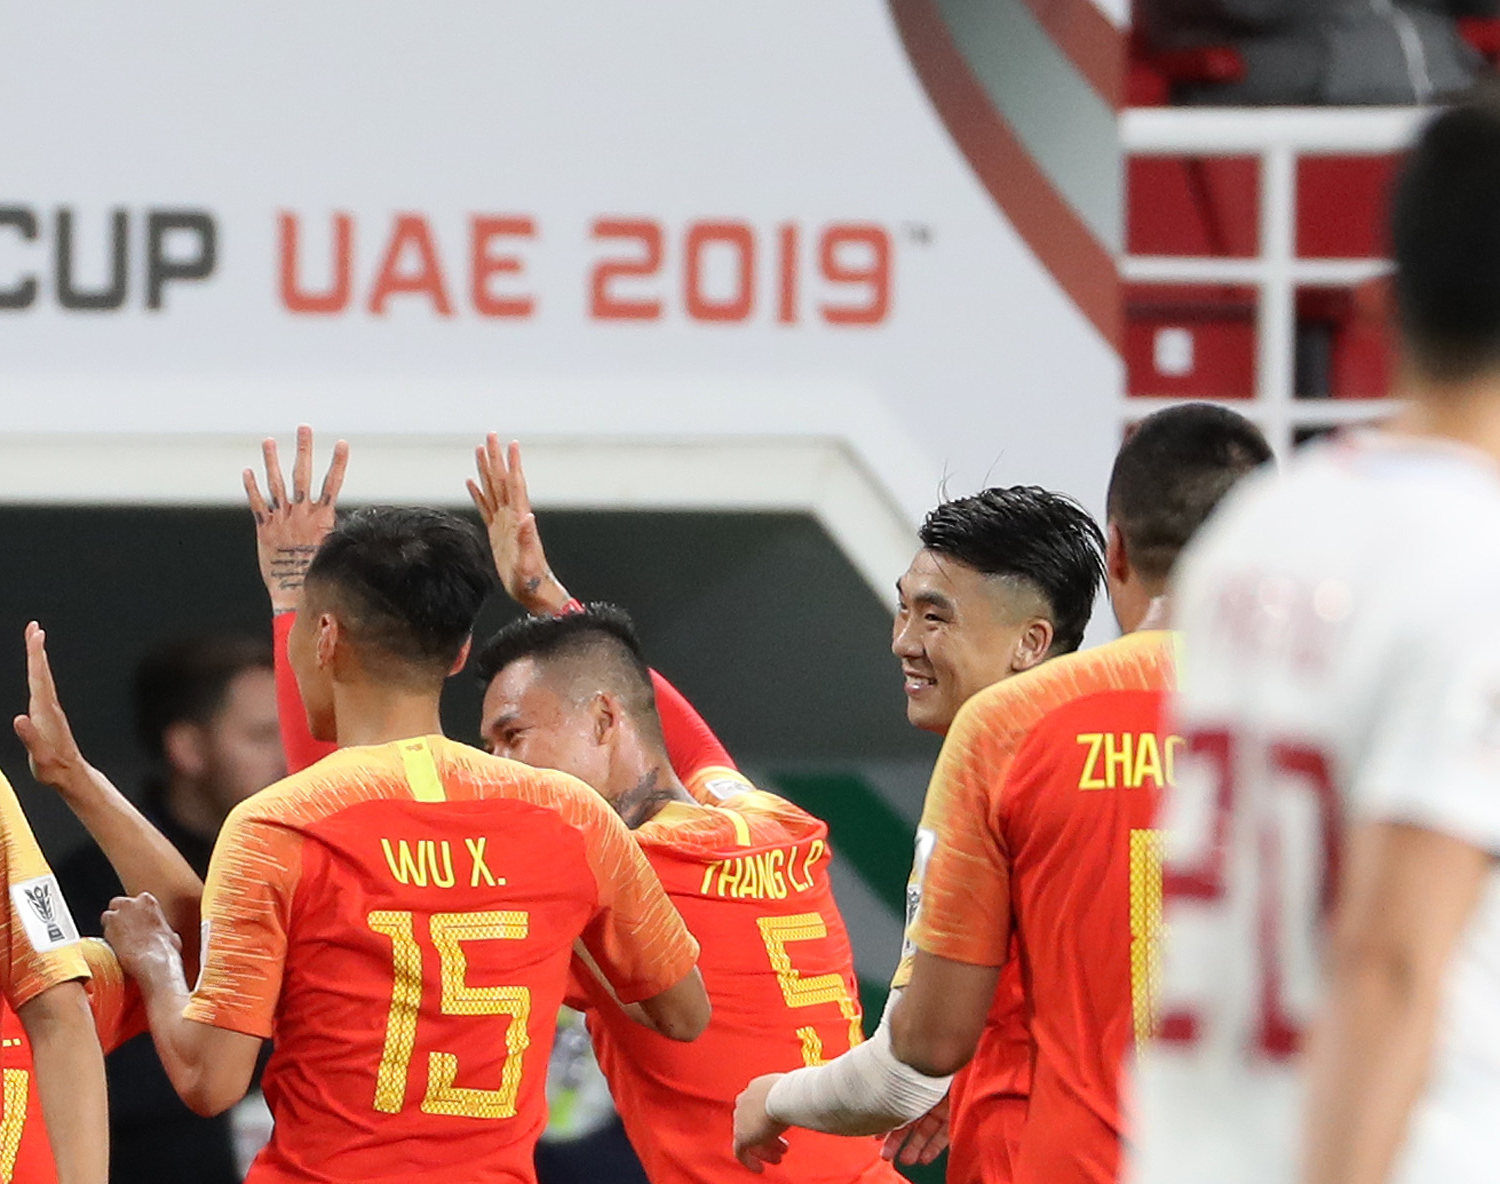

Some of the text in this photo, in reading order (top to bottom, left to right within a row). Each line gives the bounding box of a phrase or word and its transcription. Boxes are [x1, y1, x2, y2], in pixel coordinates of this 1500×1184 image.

[275, 209, 537, 317] UAE
[587, 215, 893, 325] 2019
[380, 837, 507, 888] WU X.
[367, 910, 531, 1119] 15
[756, 912, 862, 1068] 5
